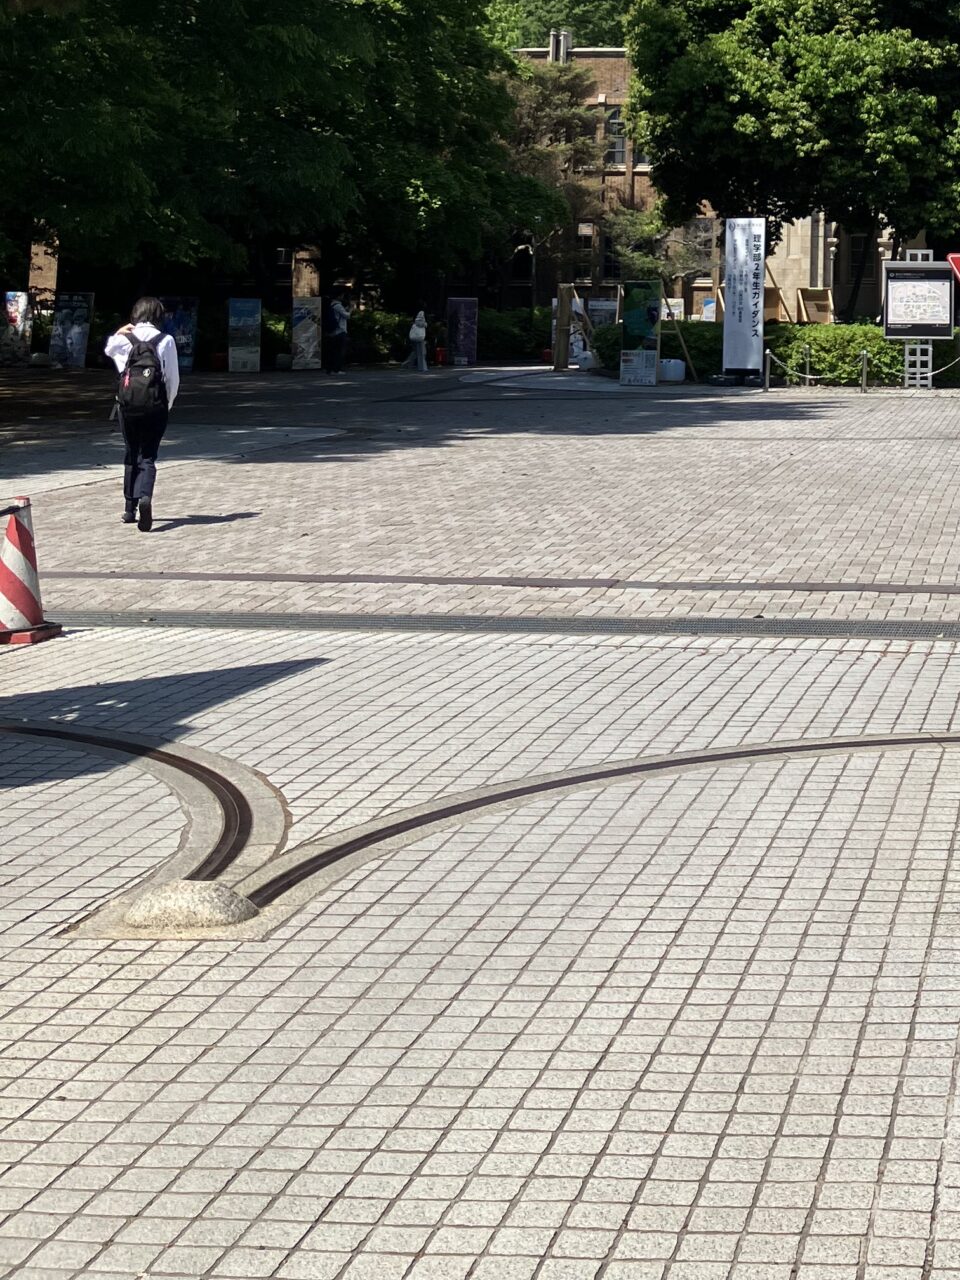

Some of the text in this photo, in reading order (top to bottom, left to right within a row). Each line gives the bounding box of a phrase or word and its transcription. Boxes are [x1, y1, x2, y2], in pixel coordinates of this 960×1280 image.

[752, 234, 761, 337] 理学部2年生ガイダンス
